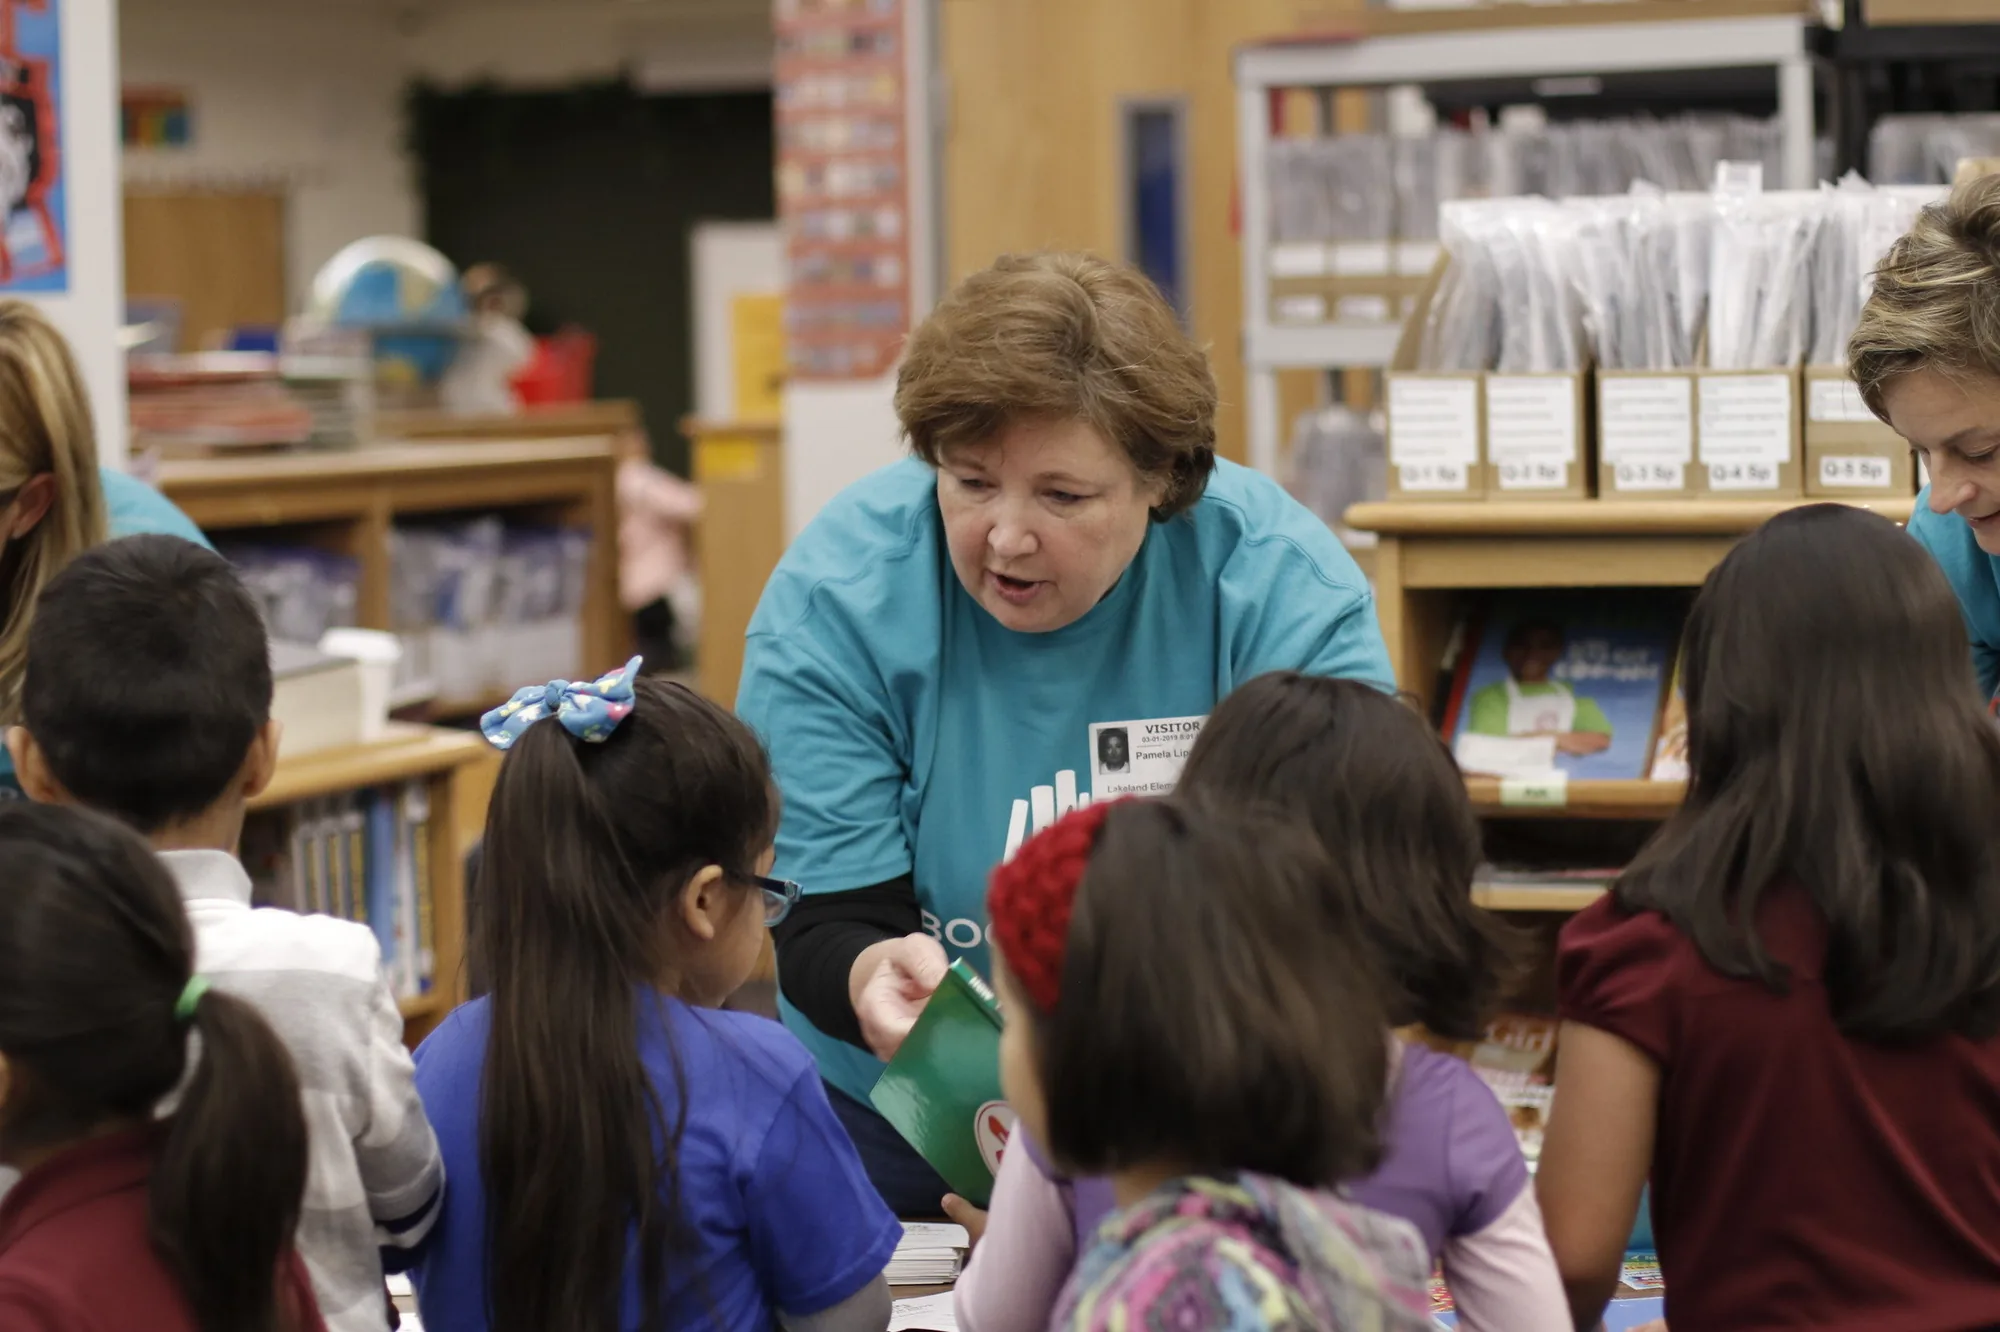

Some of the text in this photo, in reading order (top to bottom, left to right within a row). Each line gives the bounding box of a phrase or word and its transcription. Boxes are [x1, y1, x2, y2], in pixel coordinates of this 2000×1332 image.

[1144, 721, 1201, 734] VISITOR
[1135, 748, 1190, 760] Pamela Lip
[1107, 783, 1148, 793] Lakeland
[920, 908, 994, 949] BO
